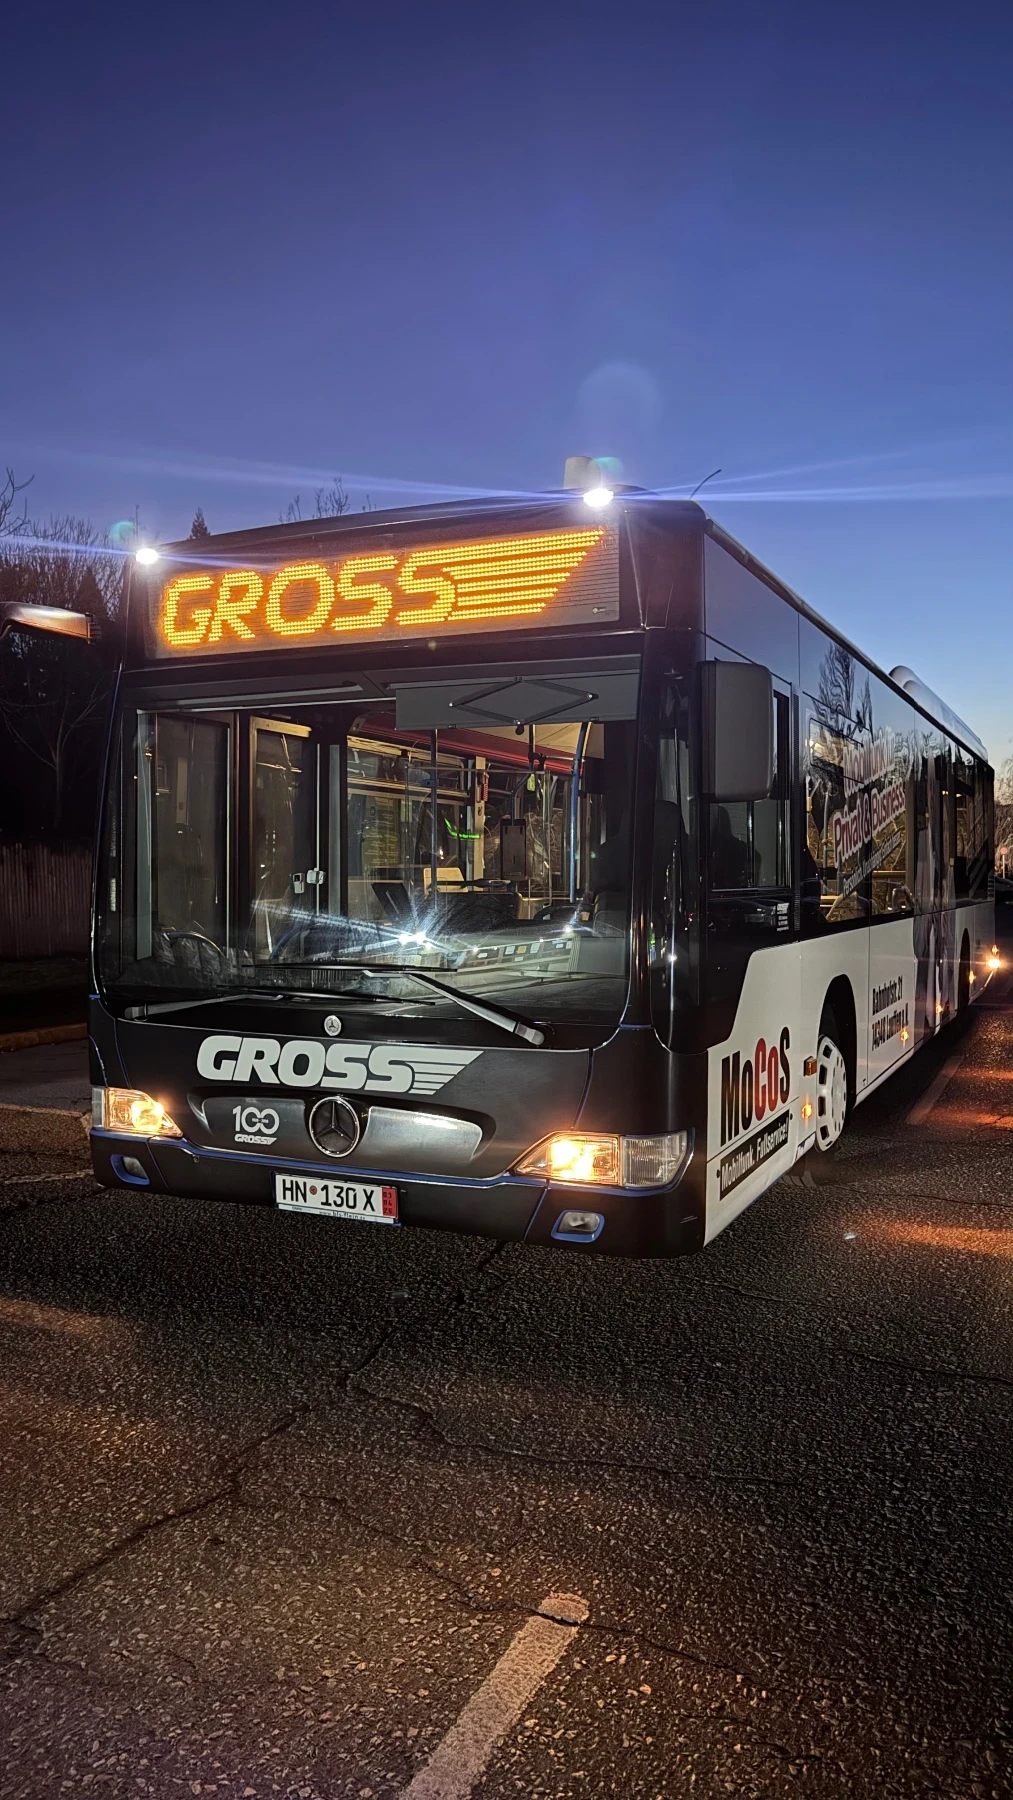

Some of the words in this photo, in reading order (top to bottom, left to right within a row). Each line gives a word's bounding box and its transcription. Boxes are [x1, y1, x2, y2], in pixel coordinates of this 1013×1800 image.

[162, 546, 464, 646] GROSS
[834, 803, 861, 867] Privat
[863, 795, 871, 842] &
[196, 1035, 420, 1094] GROSS
[720, 1026, 791, 1148] MoCoS
[232, 1105, 280, 1135] 100
[234, 1133, 274, 1145] GROSS
[721, 1144, 756, 1192] Mobilfunk.
[756, 1116, 789, 1162] Fullservice!
[282, 1179, 307, 1203] HN
[320, 1184, 357, 1210] 130
[362, 1188, 376, 1213] X
